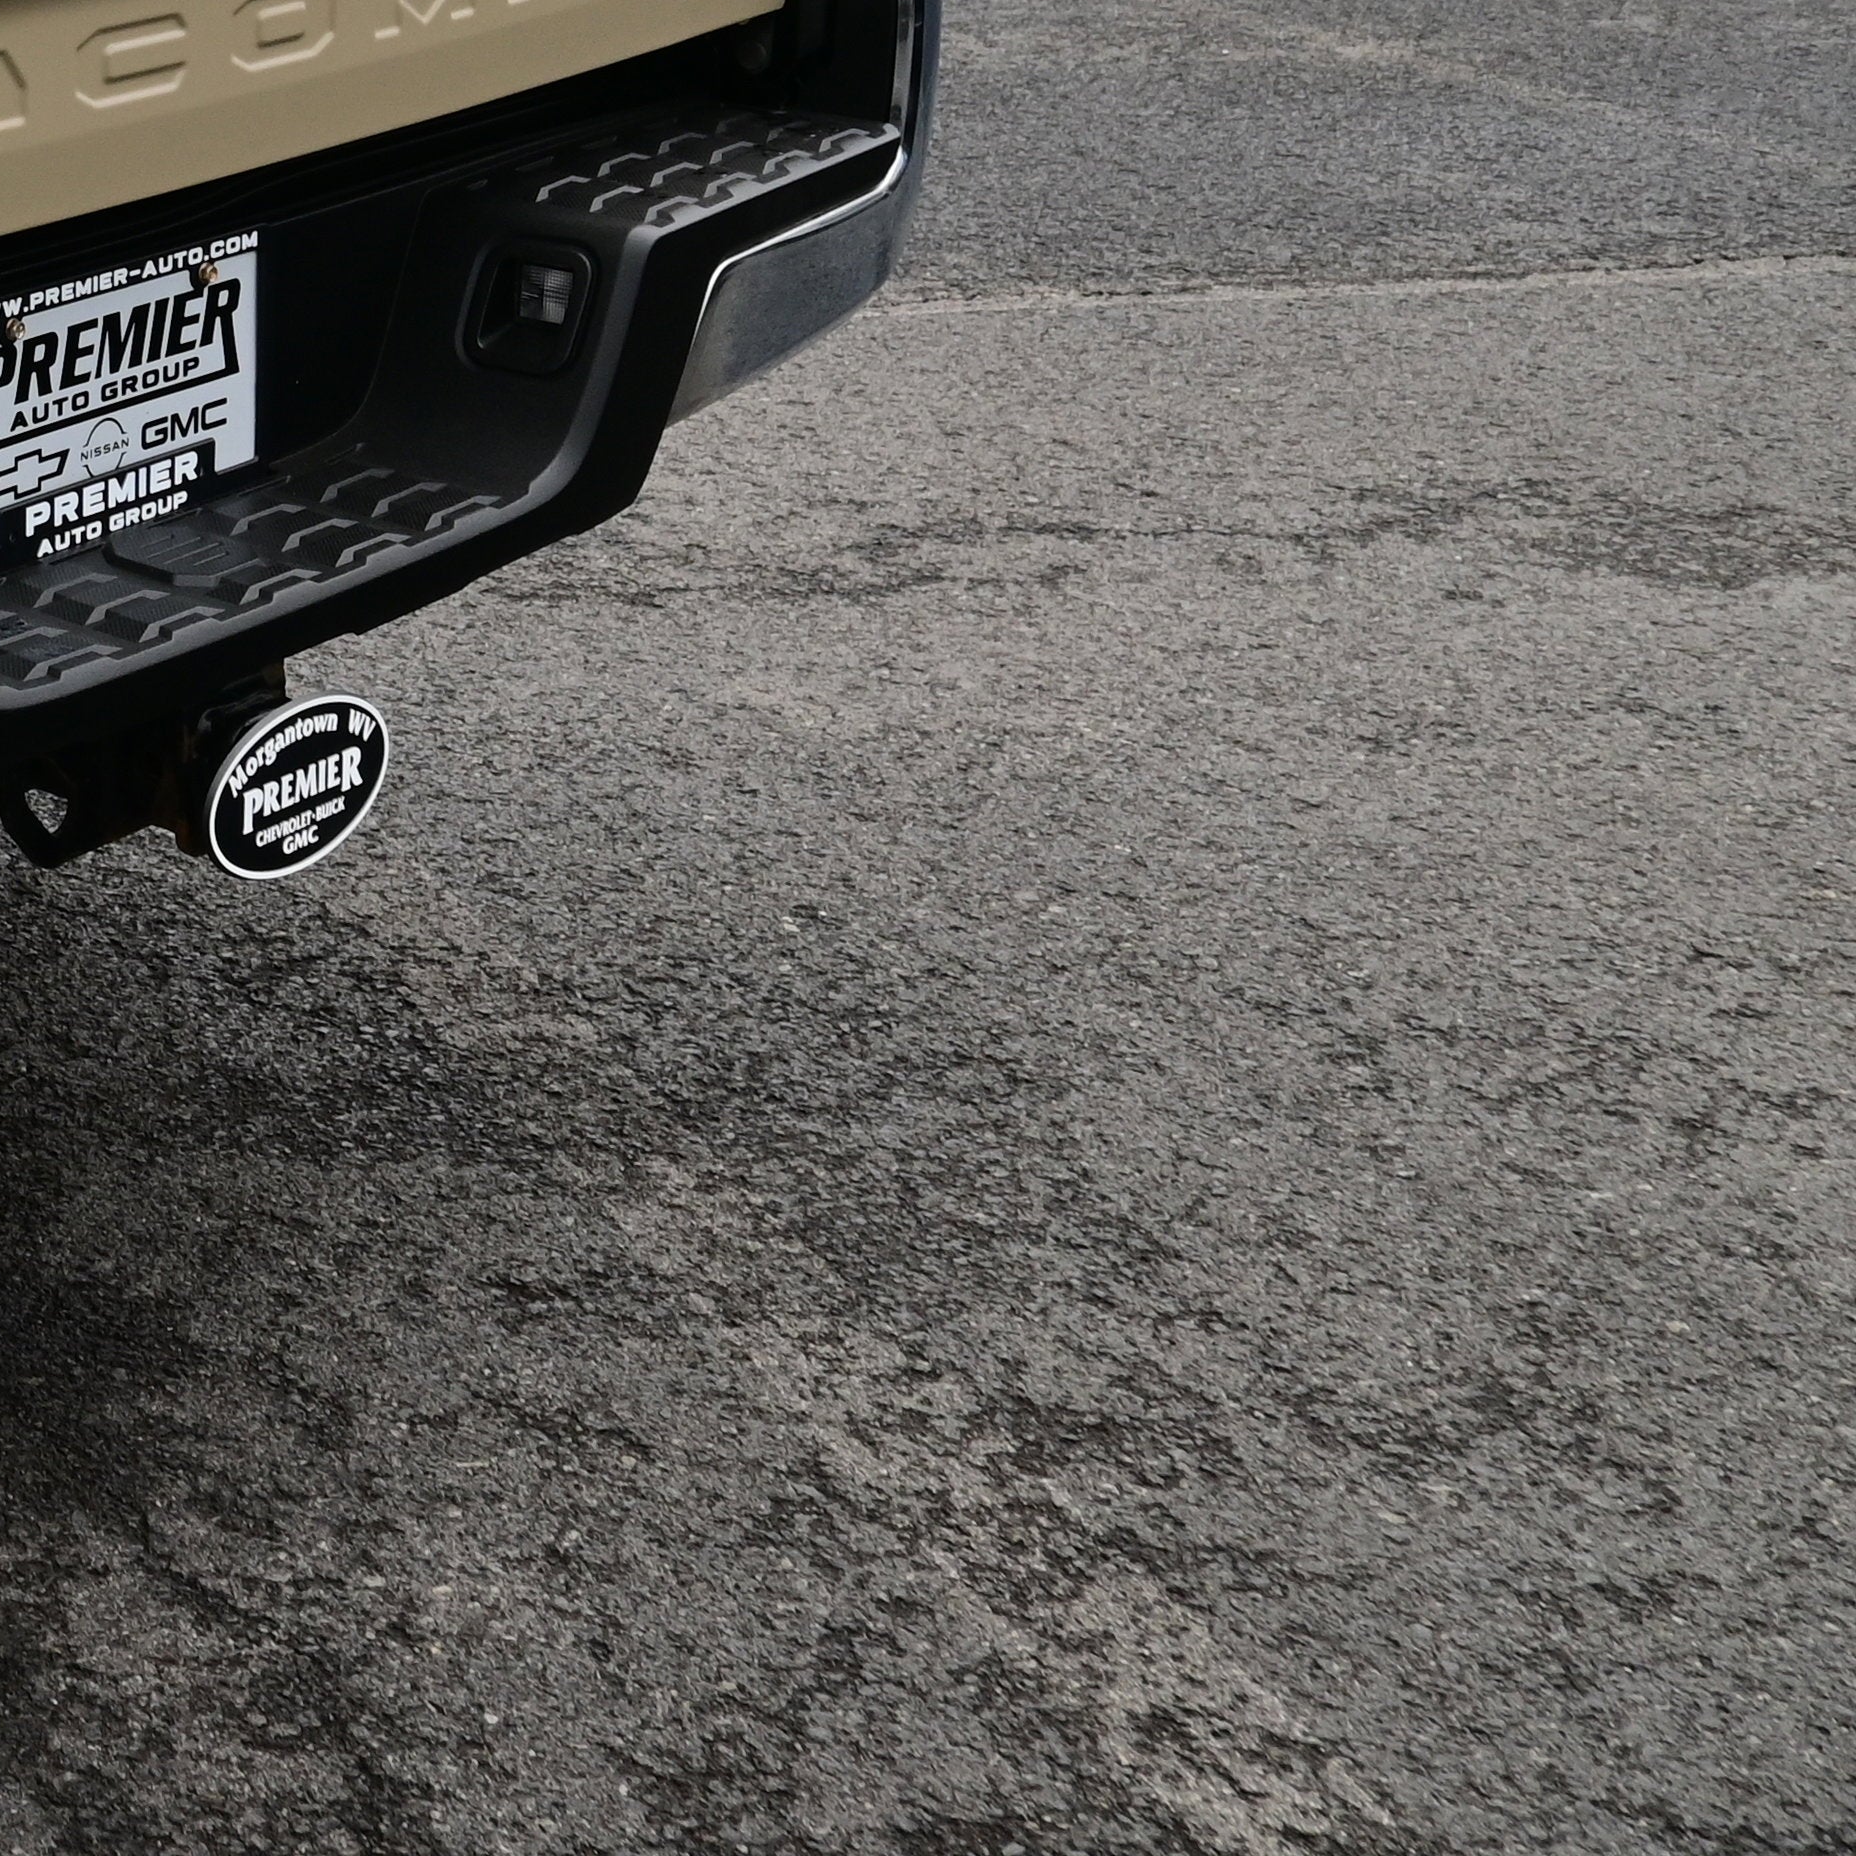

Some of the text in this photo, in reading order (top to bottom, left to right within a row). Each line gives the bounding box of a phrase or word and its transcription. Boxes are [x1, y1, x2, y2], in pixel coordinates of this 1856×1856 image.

[10, 356, 200, 432] AUTO GROUP
[141, 397, 228, 450] GMC
[81, 437, 130, 462] NISSAN
[25, 451, 199, 537] PREMIER
[37, 491, 188, 558] AUTO GROUP
[228, 708, 376, 798] Morgantown WV
[243, 746, 363, 835] PREMIER
[282, 825, 319, 855] GMC
